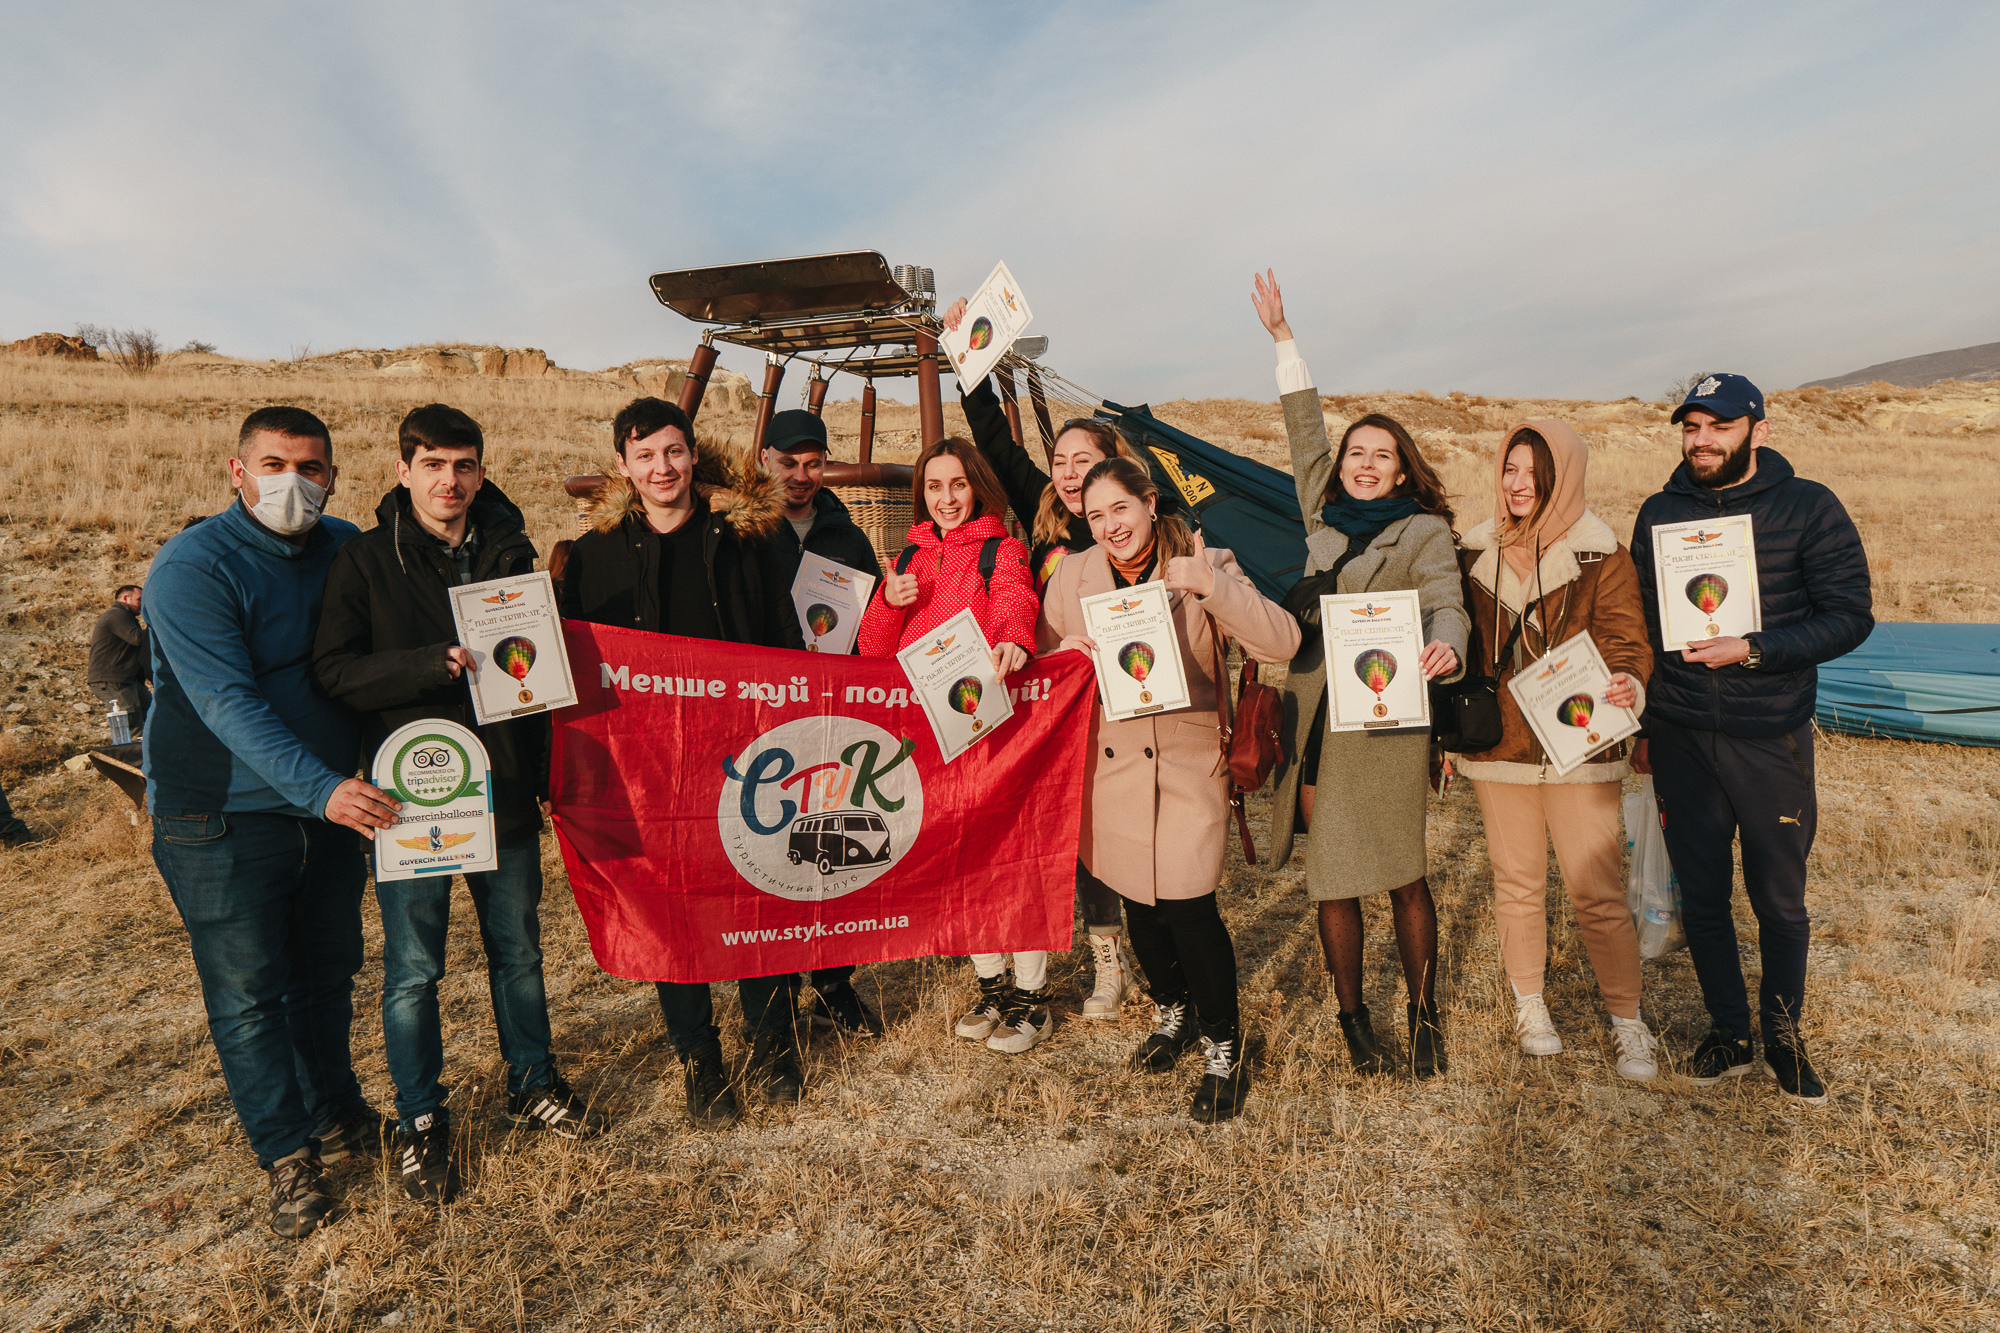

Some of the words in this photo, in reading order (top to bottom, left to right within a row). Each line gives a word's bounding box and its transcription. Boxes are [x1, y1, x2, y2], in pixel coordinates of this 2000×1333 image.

[1182, 484, 1197, 502] 500
[1196, 482, 1208, 492] N
[475, 618, 498, 627] FLIGHT
[499, 609, 540, 622] CERTIFICATE
[600, 663, 726, 698] Менше
[737, 676, 810, 708] жуй
[407, 775, 457, 786] tripadvisor
[399, 858, 435, 866] GUVERCIN
[438, 853, 475, 862] BALLOONS
[734, 835, 813, 892] туристичний
[824, 875, 858, 892] клуб
[721, 915, 909, 946] www.styk.com.ua
